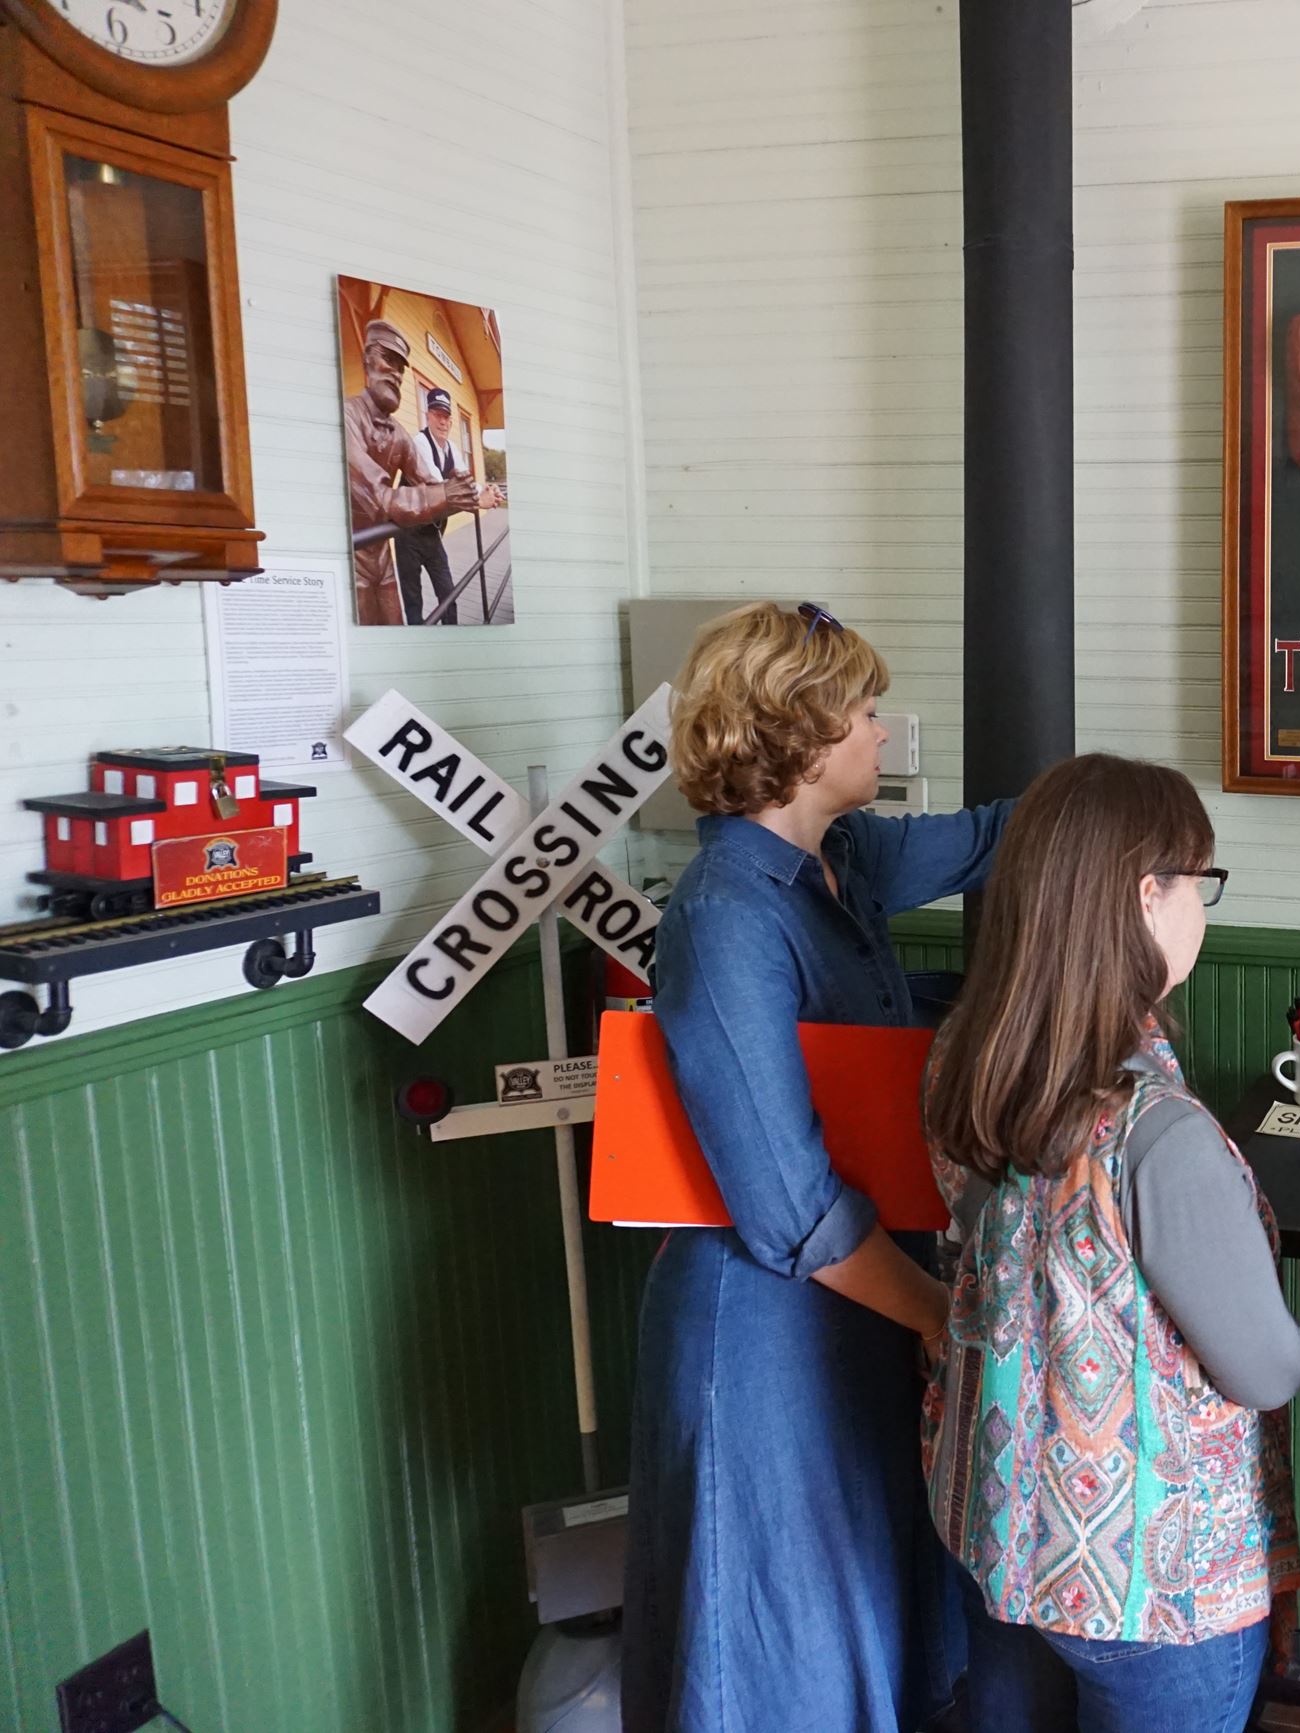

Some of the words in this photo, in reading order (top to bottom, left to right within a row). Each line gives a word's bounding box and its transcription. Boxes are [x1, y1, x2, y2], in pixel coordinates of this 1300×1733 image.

[106, 7, 128, 45] 6
[271, 576, 302, 586] Service
[304, 577, 325, 589] Story
[378, 718, 505, 843] RAIL
[563, 870, 658, 970] ROA
[185, 867, 259, 887] DONATIONS
[406, 730, 668, 1001] CROSSING
[161, 886, 213, 903] GLADLY
[215, 875, 281, 895] ACCEPTED
